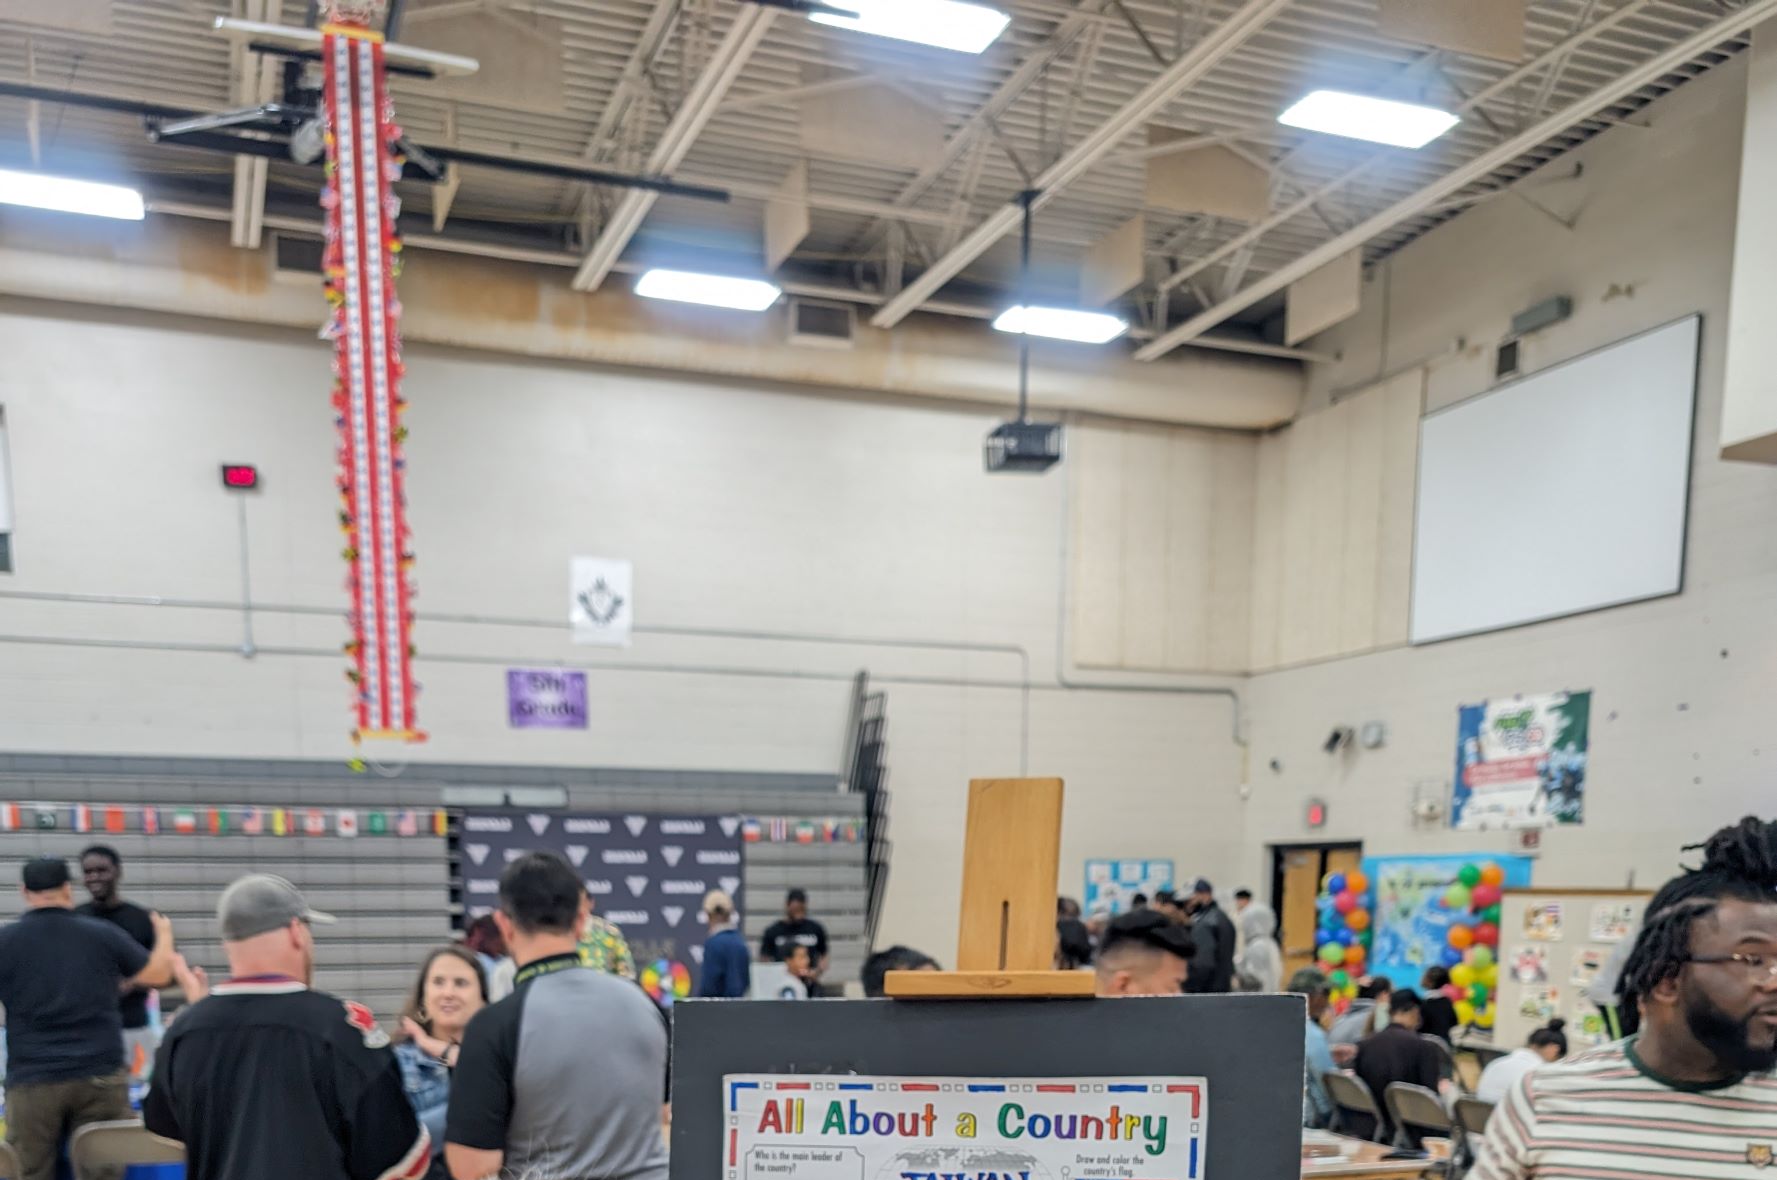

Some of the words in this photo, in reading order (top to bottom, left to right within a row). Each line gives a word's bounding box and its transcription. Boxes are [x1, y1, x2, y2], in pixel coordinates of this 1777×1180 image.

[757, 1097, 805, 1134] All
[821, 1098, 937, 1137] About
[955, 1112, 977, 1138] a
[997, 1102, 1168, 1156] Country
[755, 1149, 769, 1160] Who
[771, 1150, 778, 1160] is
[779, 1150, 790, 1160] the
[792, 1151, 809, 1161] main
[811, 1151, 833, 1161] leader
[835, 1151, 842, 1162] of
[1076, 1153, 1094, 1164] Draw
[1097, 1154, 1110, 1165] and
[1112, 1154, 1130, 1165] color
[1132, 1154, 1144, 1165] the
[754, 1162, 765, 1172] the
[767, 1162, 797, 1175] country?
[1083, 1167, 1116, 1178] country's
